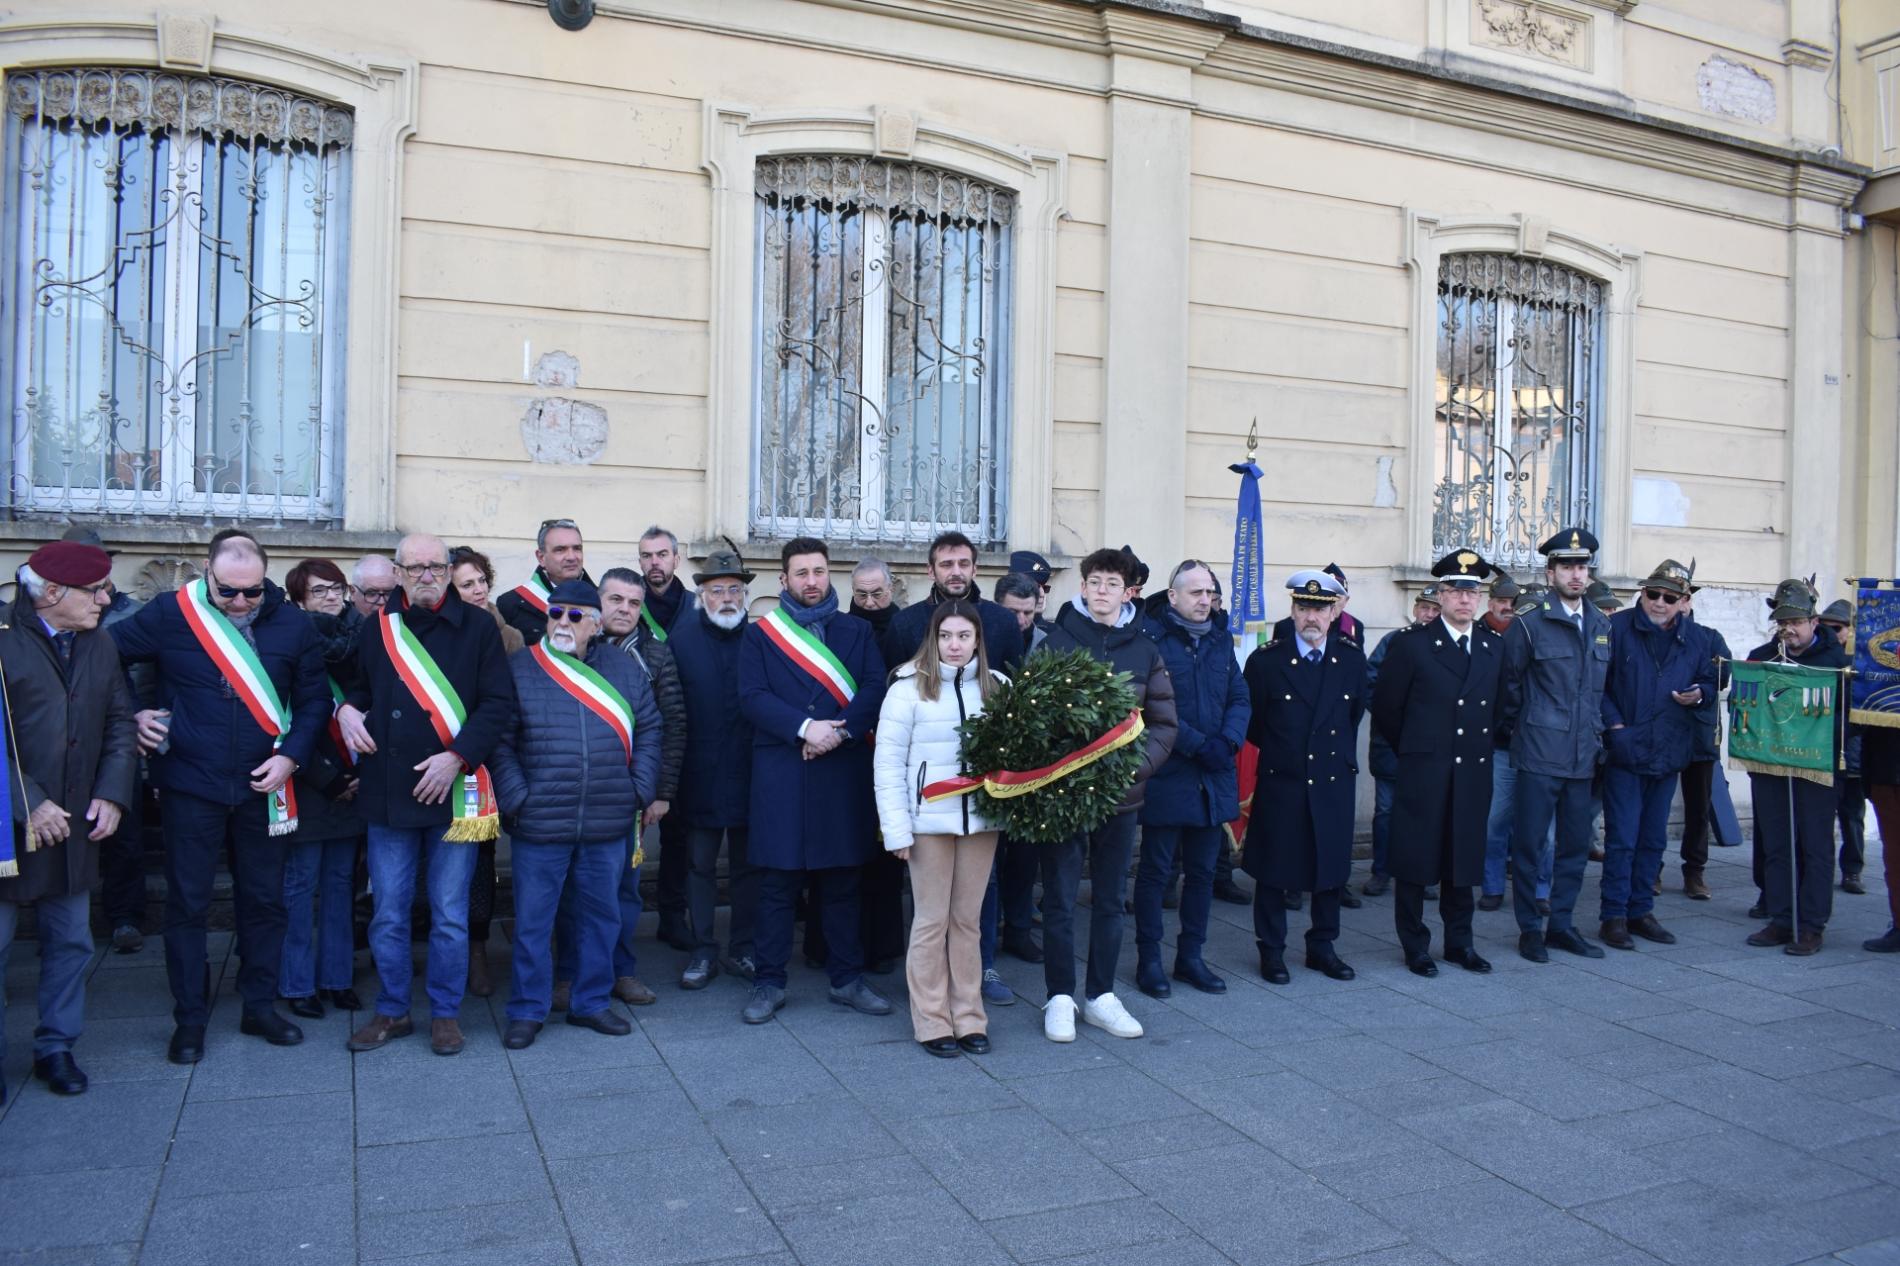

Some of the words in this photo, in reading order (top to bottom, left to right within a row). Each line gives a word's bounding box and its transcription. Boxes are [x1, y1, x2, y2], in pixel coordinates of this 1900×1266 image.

[1239, 517, 1248, 543] STATO
[1239, 545, 1246, 555] DI
[1236, 555, 1246, 589] POLIZIA
[1249, 563, 1259, 590] CASALE
[1250, 590, 1259, 616] GRUPPO
